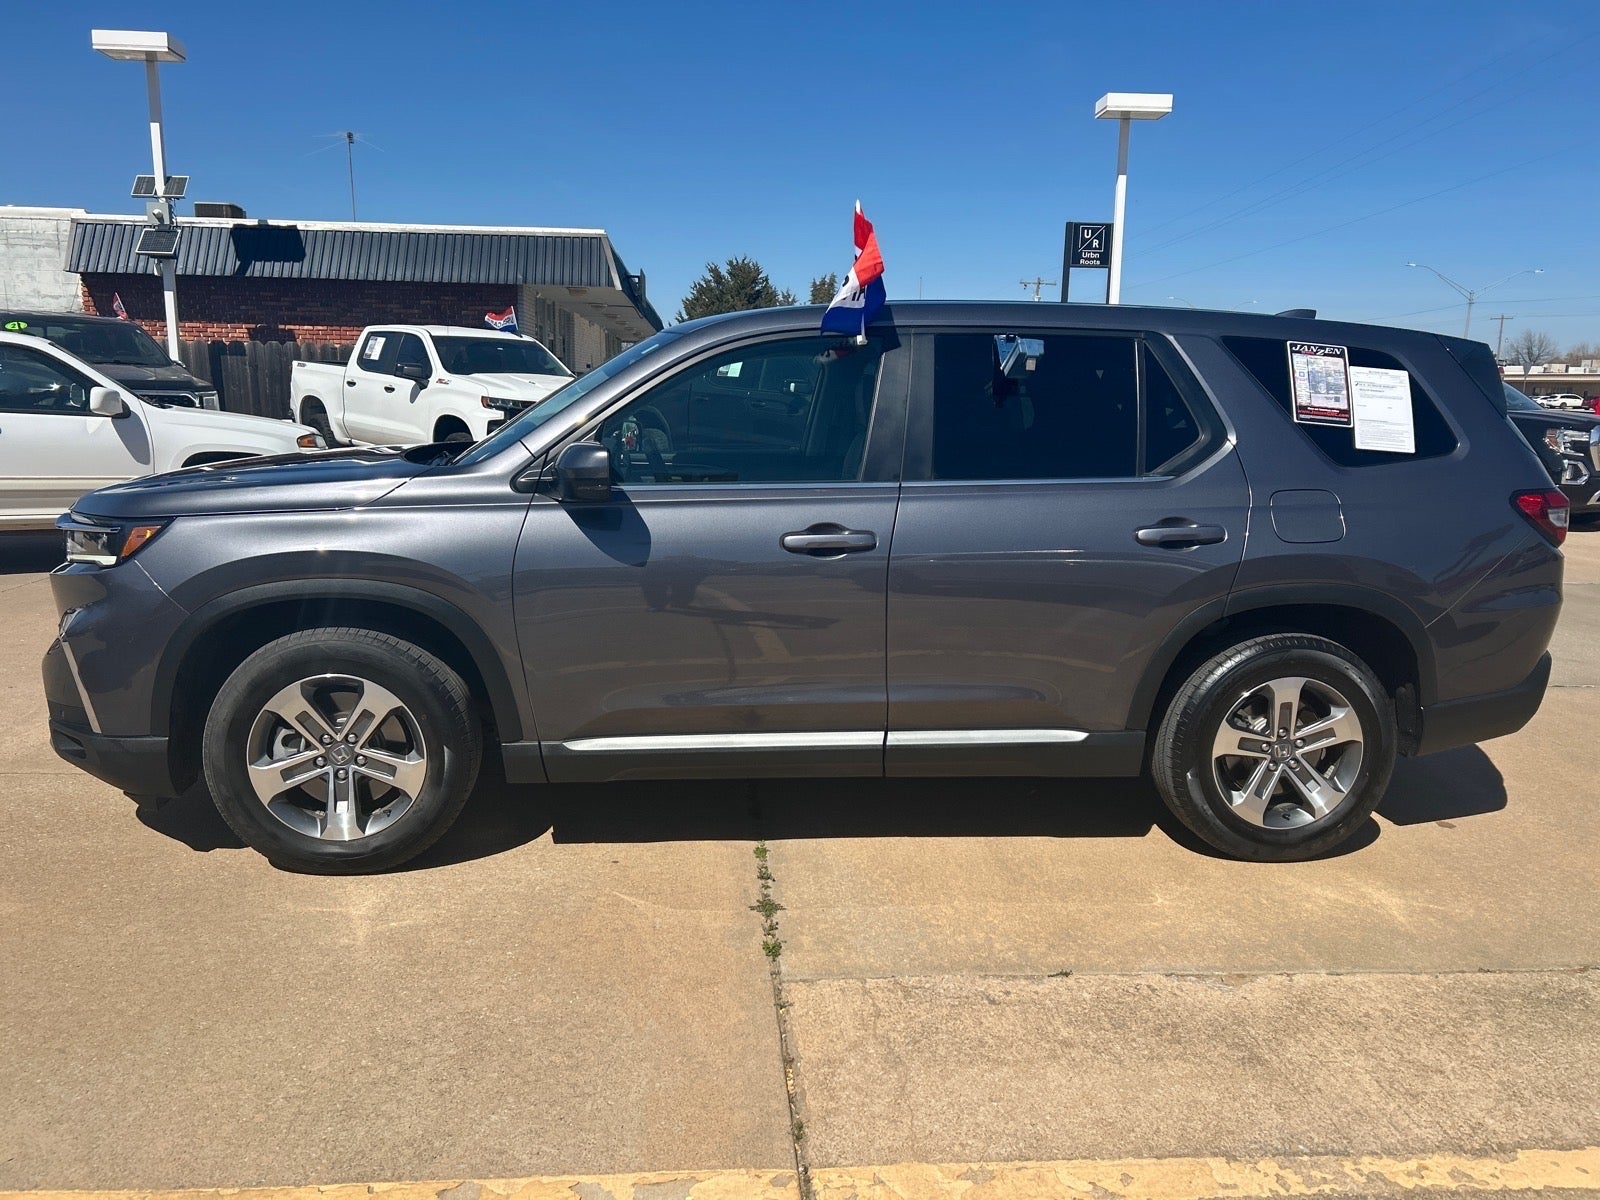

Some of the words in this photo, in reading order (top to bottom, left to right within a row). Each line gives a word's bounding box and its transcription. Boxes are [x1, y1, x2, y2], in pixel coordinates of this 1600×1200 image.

[1084, 229, 1092, 238] U
[1092, 239, 1099, 248] R
[1292, 344, 1342, 356] JANZEN
